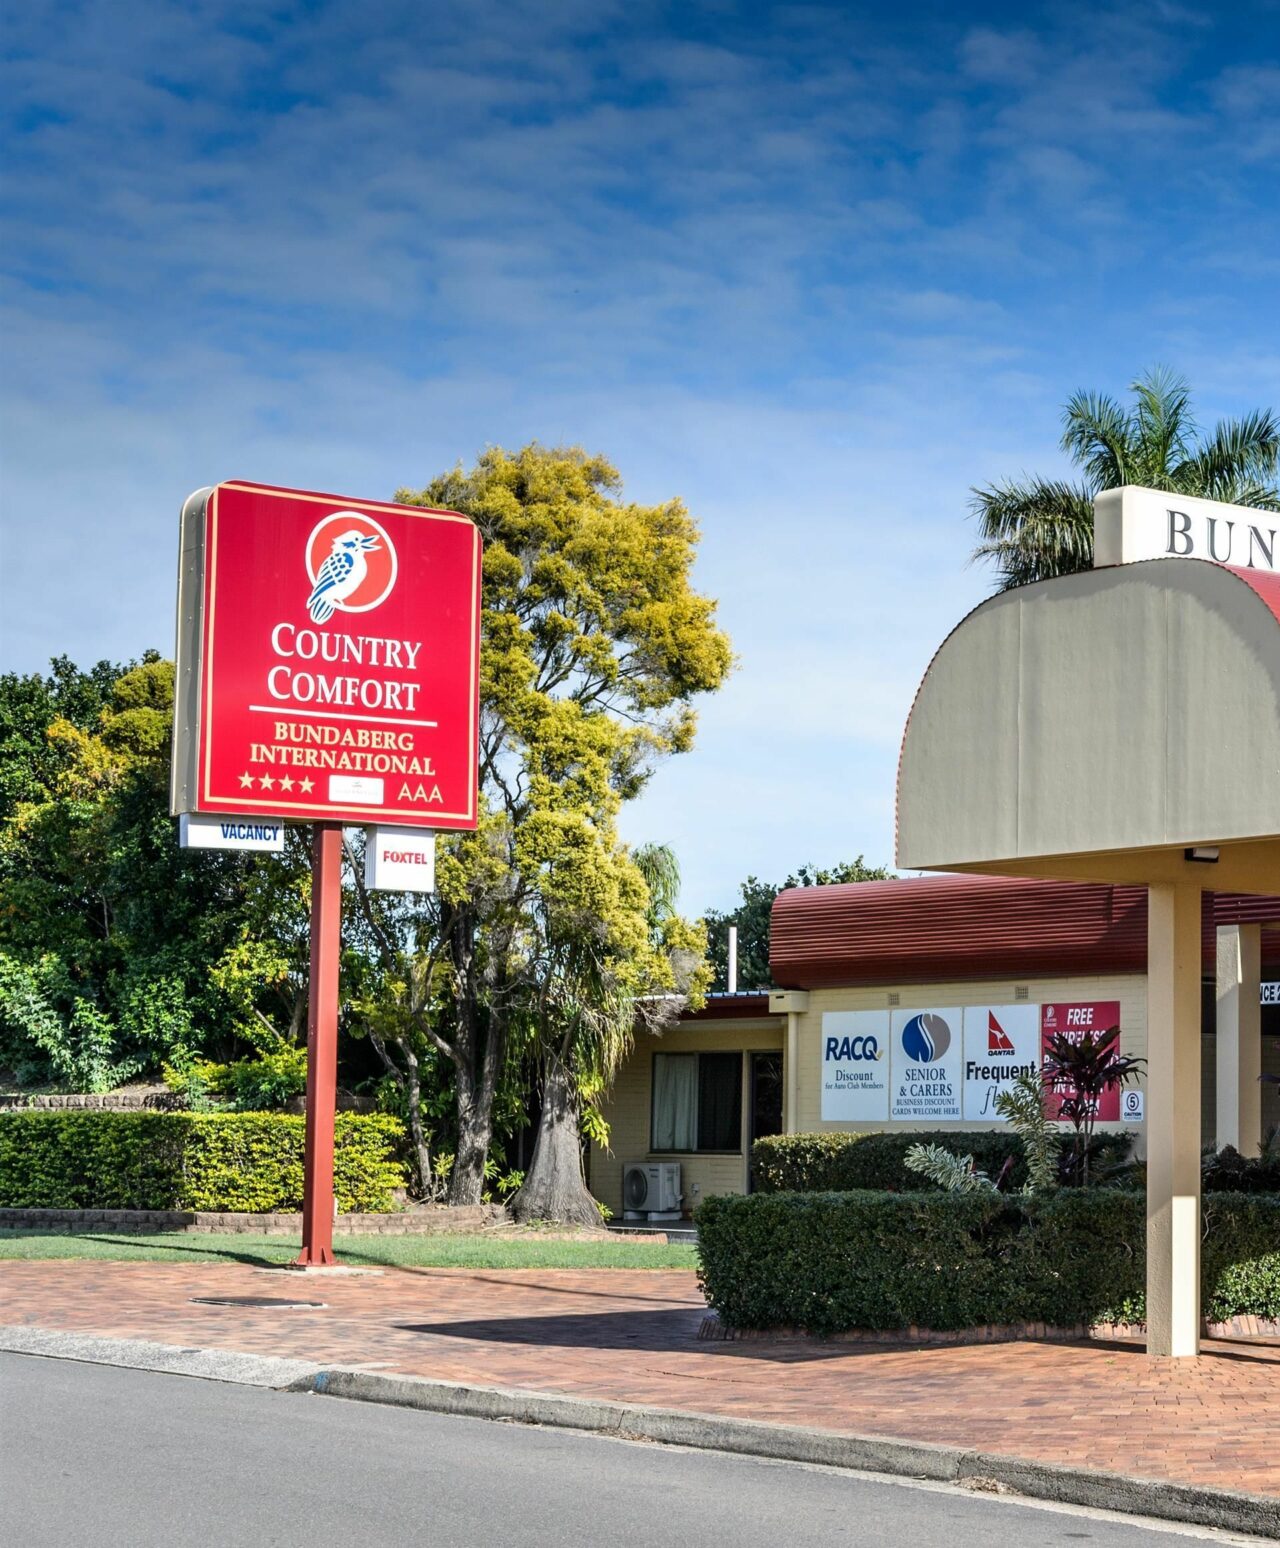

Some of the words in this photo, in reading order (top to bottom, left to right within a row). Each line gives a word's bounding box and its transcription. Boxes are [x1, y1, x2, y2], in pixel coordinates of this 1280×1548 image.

[271, 622, 423, 669] COUNTRY
[267, 665, 421, 712] COMFORT
[274, 721, 414, 751] BUNDABERG
[249, 743, 436, 776] INTERNATIONAL
[398, 782, 444, 803] AAA
[220, 823, 280, 842] VACANCY
[383, 850, 428, 865] FOXTEL
[1067, 1008, 1094, 1025] FREE
[825, 1035, 880, 1061] RACQ
[835, 1070, 873, 1081] Discount
[905, 1068, 946, 1081] SENIOR
[966, 1061, 1036, 1083] Frequent
[899, 1086, 907, 1096] &
[910, 1084, 952, 1097] CARERS
[896, 1098, 923, 1106] BUSINESS
[924, 1098, 955, 1106] DISCOUNT
[912, 1107, 942, 1115] WELCOME
[944, 1107, 960, 1115] HERE
[1130, 1096, 1136, 1108] 5
